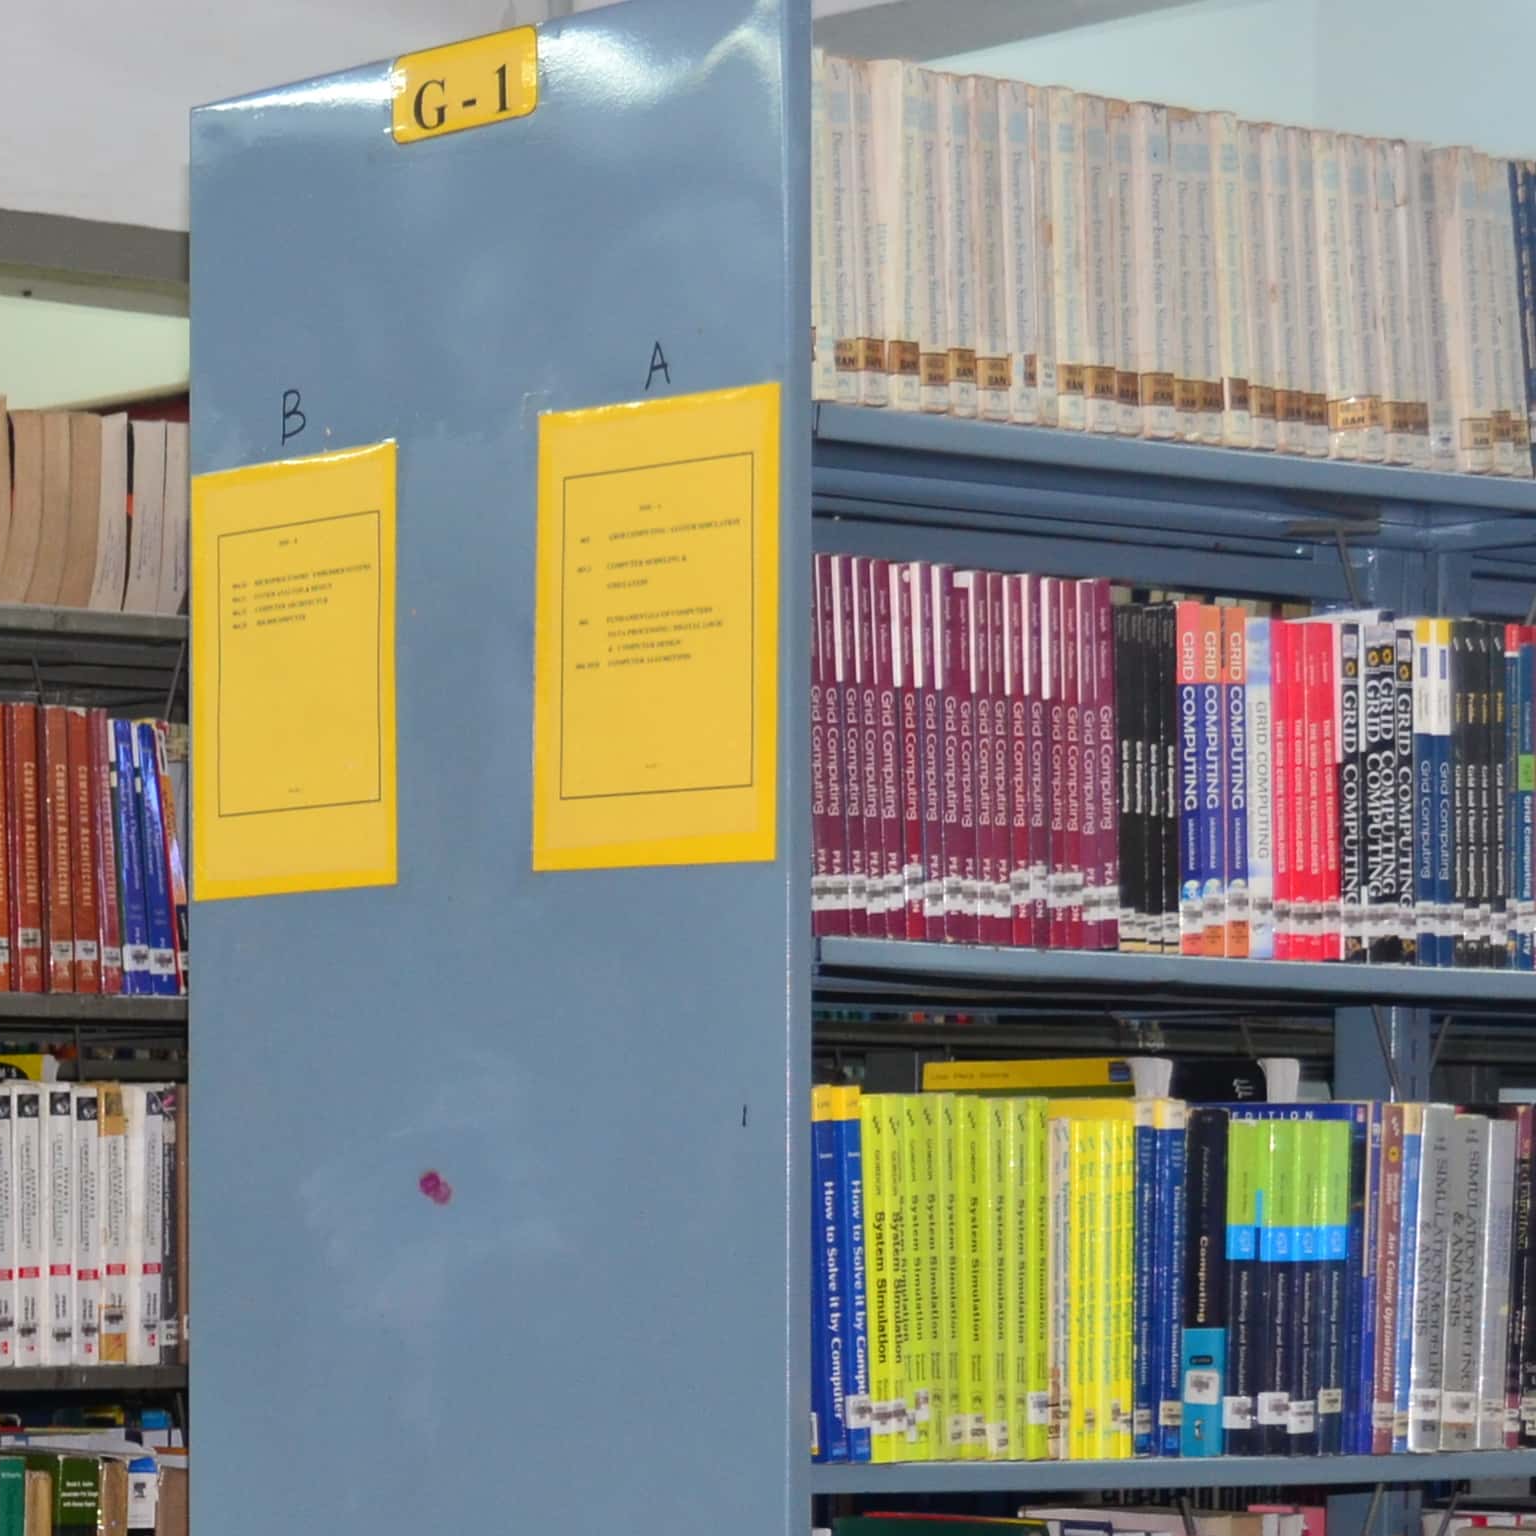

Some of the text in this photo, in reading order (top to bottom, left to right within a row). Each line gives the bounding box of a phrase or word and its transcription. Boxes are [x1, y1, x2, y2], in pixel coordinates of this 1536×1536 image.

[644, 341, 671, 389] A
[281, 389, 307, 446] B
[827, 687, 840, 817] Grid Computing
[905, 693, 917, 821] Grid Computing
[1100, 705, 1114, 830] Grid Computing
[1182, 631, 1198, 811] GRID COMPUTING
[1255, 702, 1270, 860] GRID COMPUTING
[1367, 679, 1382, 898] GRID COMPUTING
[1420, 760, 1432, 880] Grid Computing
[824, 1181, 834, 1220] How
[826, 1226, 834, 1243] to
[827, 1248, 837, 1292] Solve
[828, 1312, 840, 1332] by
[872, 1211, 889, 1364] System Simulation
[1197, 1236, 1208, 1324] Computing
[830, 1338, 845, 1419] Computer
